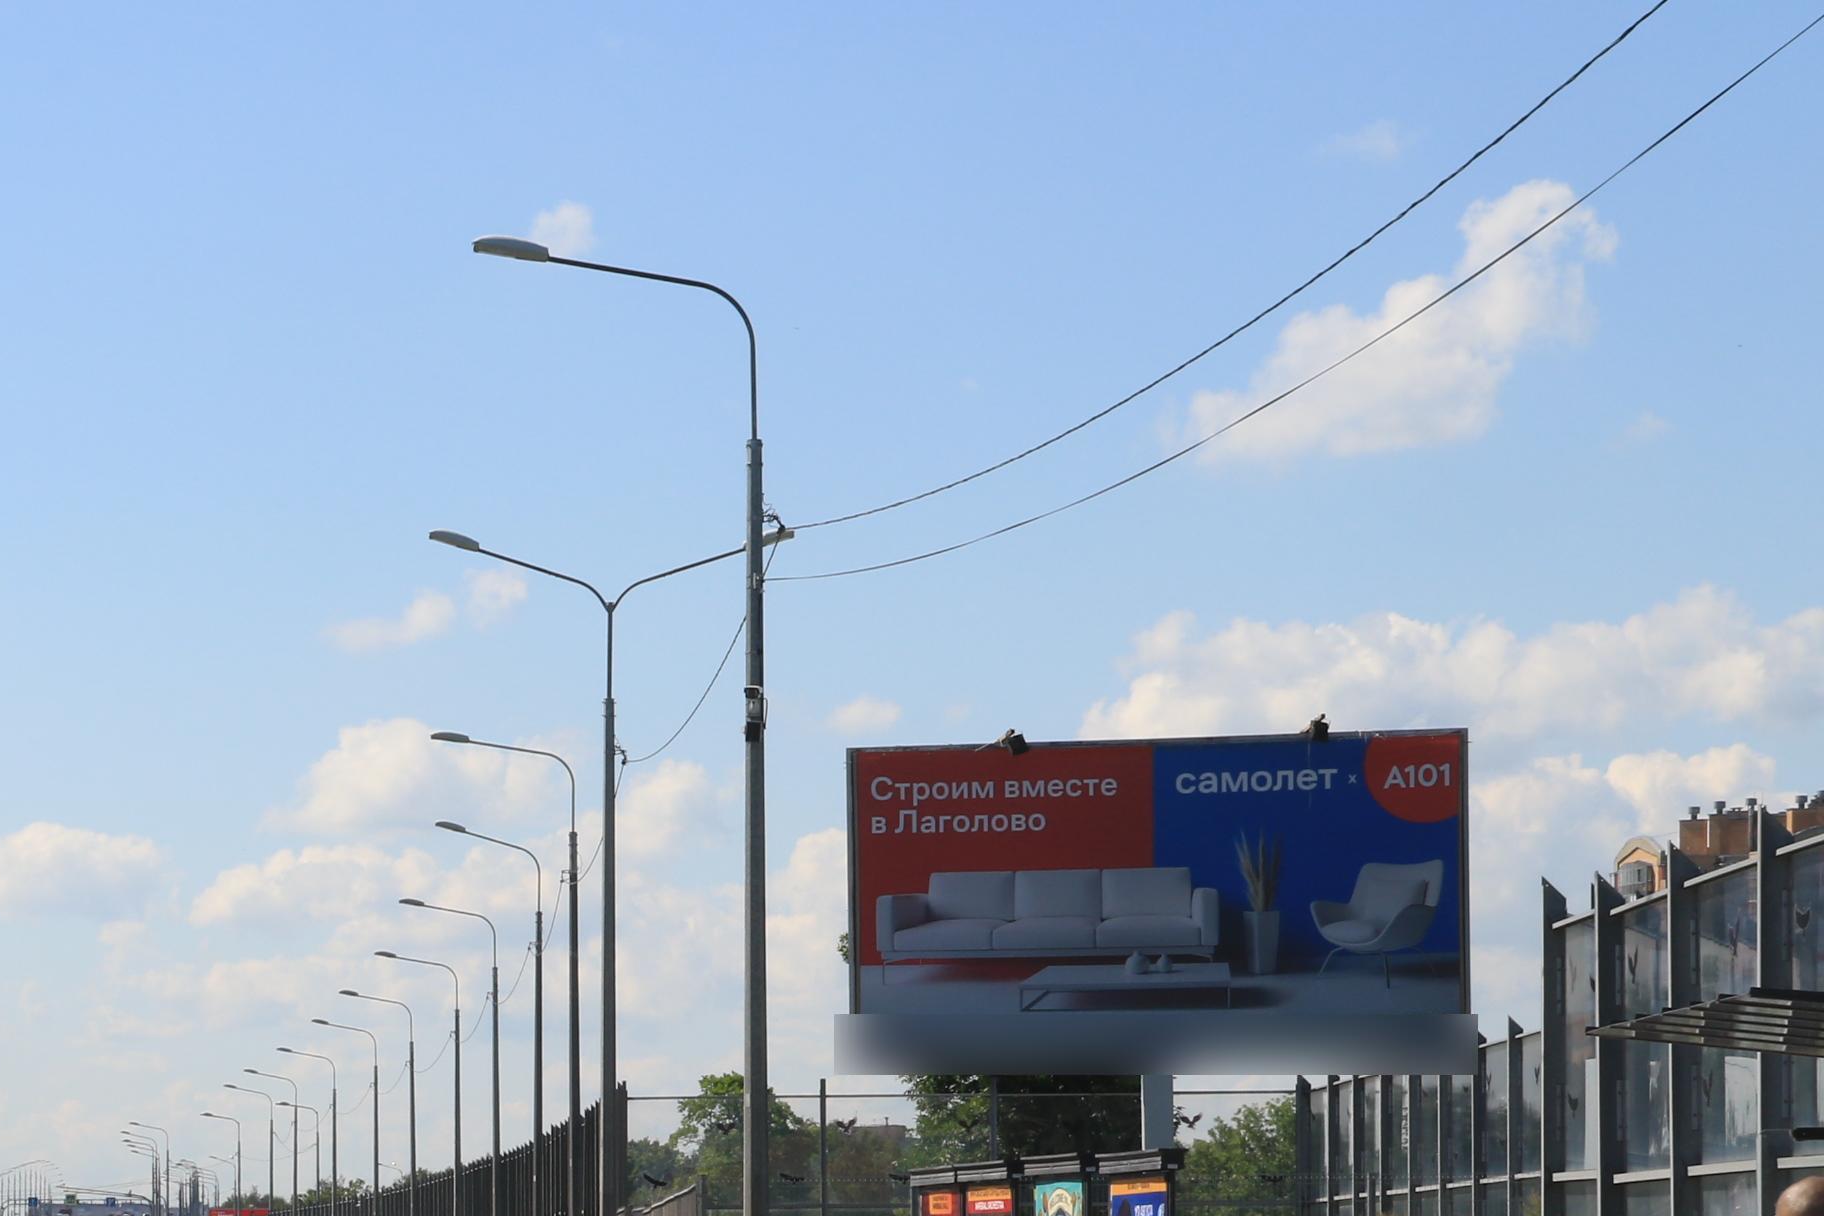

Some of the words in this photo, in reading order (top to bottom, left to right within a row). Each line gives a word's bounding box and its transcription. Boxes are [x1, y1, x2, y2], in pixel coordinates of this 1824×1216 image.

[870, 776, 995, 807] Строим
[1004, 777, 1118, 799] вместе
[1175, 768, 1339, 795] самолет
[871, 815, 887, 834] в
[895, 810, 1047, 835] Лаголово
